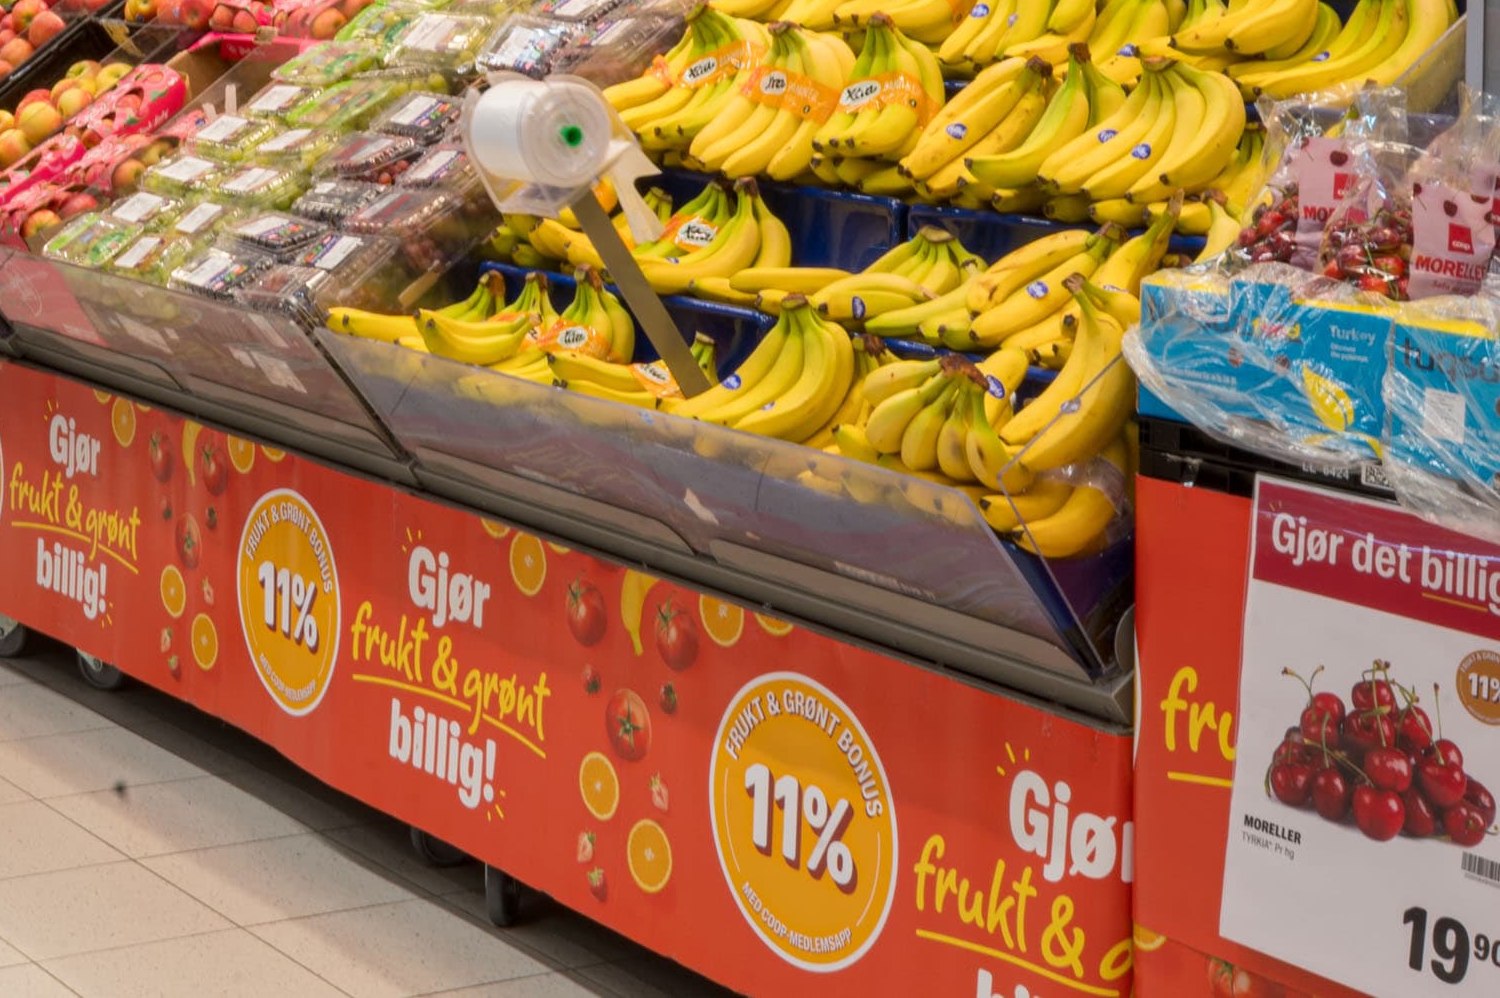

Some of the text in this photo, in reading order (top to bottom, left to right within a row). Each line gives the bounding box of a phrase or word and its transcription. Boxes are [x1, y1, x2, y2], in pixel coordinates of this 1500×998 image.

[1330, 324, 1376, 346] Turkey
[49, 414, 101, 479] Gjør
[9, 461, 141, 562] frukt & grønt
[245, 501, 333, 594] FRUKT & GRØNT BONUS
[1271, 512, 1345, 567] Gjør
[1351, 532, 1412, 584] det
[36, 537, 107, 620] billig!
[258, 560, 319, 654] 11%
[408, 545, 490, 629] Gjør
[352, 601, 551, 741] frukt & grønt
[1160, 666, 1237, 761] fru
[389, 697, 496, 809] billig!
[725, 689, 884, 819] FRUKT & GRØNT BONUS
[744, 762, 856, 890] 11%
[1243, 813, 1302, 845] MORELLER
[741, 880, 853, 954] MED COOP-MEDLEMSAPP
[913, 834, 1038, 953] frukt
[1040, 894, 1086, 979] &
